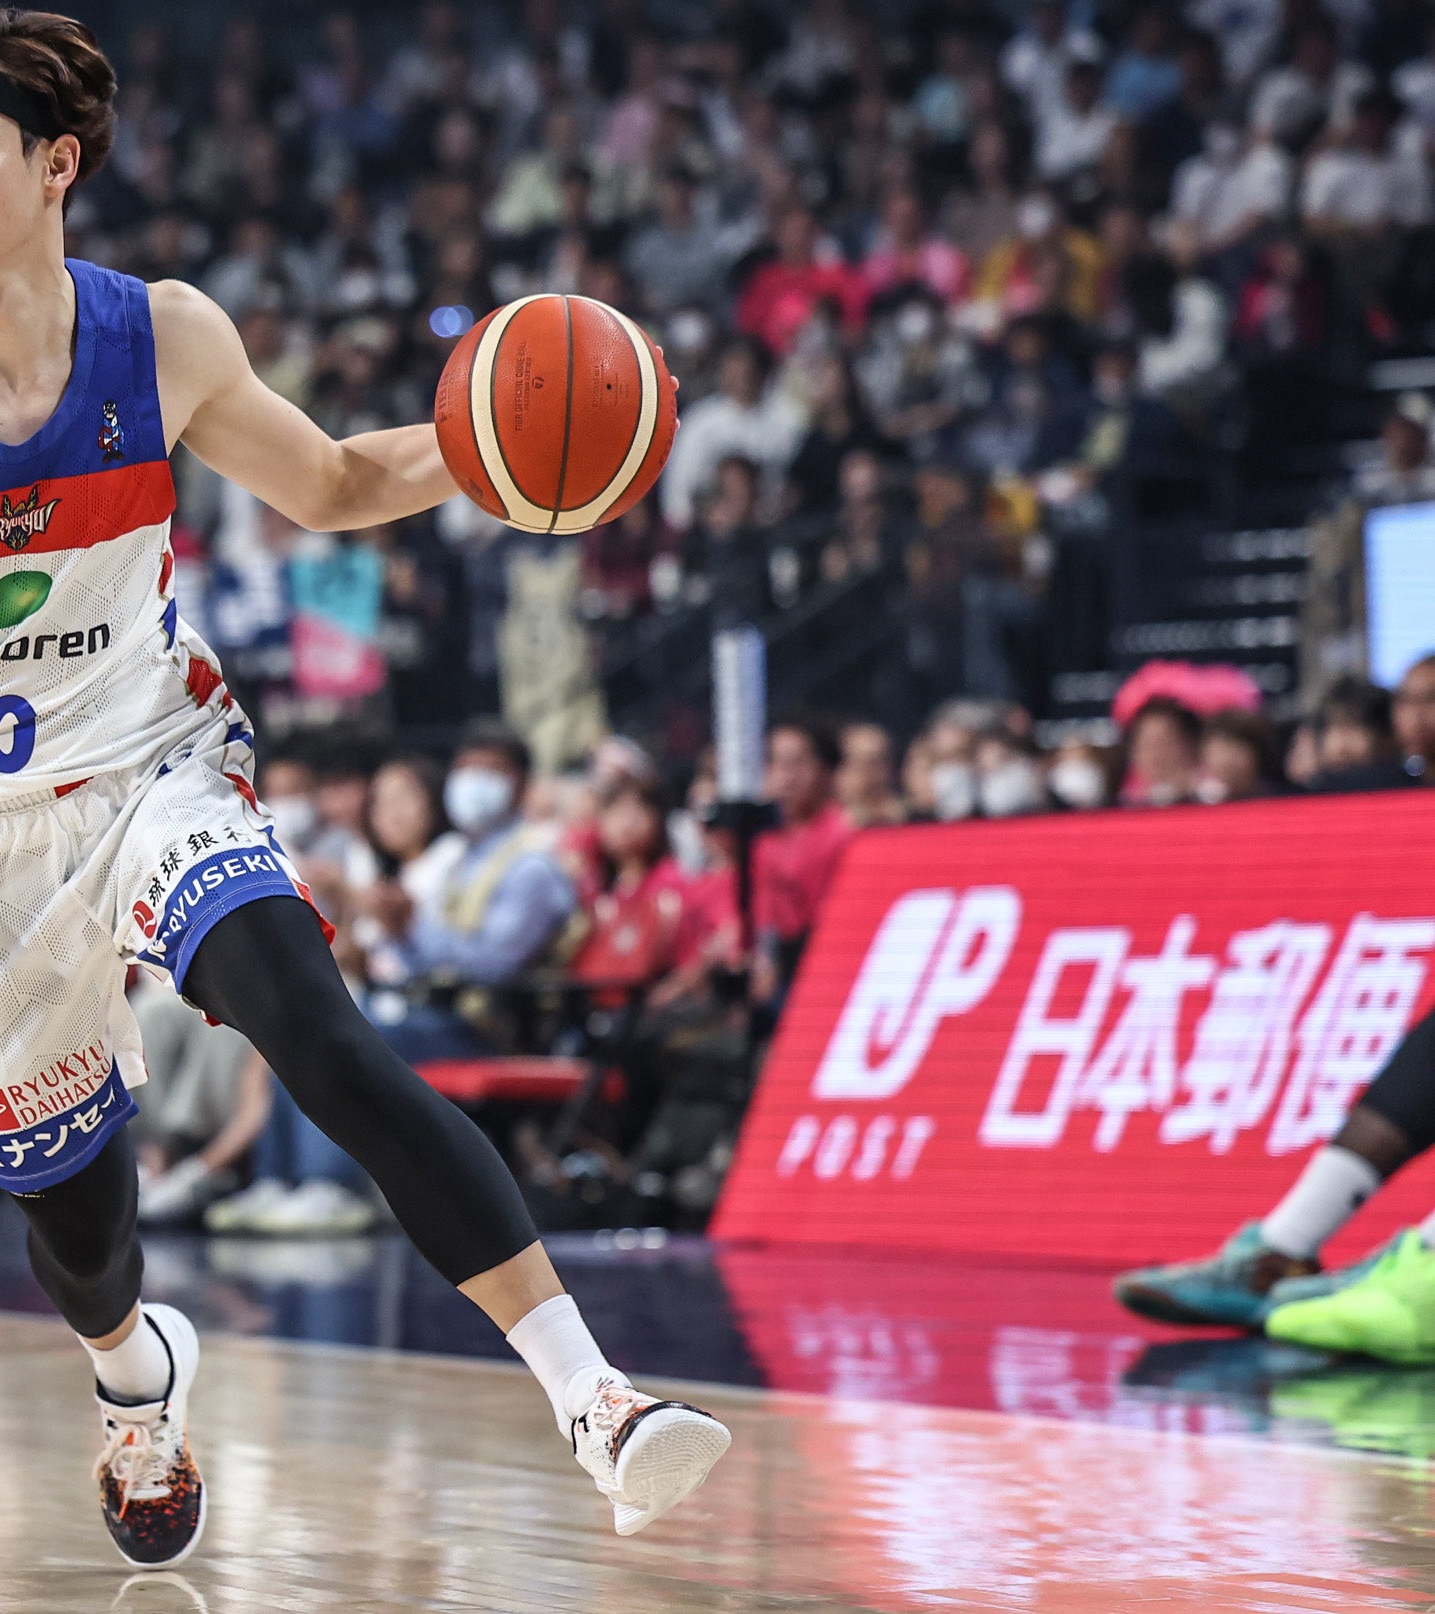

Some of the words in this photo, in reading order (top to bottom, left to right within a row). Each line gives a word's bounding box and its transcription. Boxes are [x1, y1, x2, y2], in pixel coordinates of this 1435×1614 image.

[978, 911, 1435, 1157] 日本郵便
[7, 1039, 106, 1106] RYUKYU
[19, 1056, 112, 1126] DAIHATSU
[778, 1114, 936, 1180] POST
